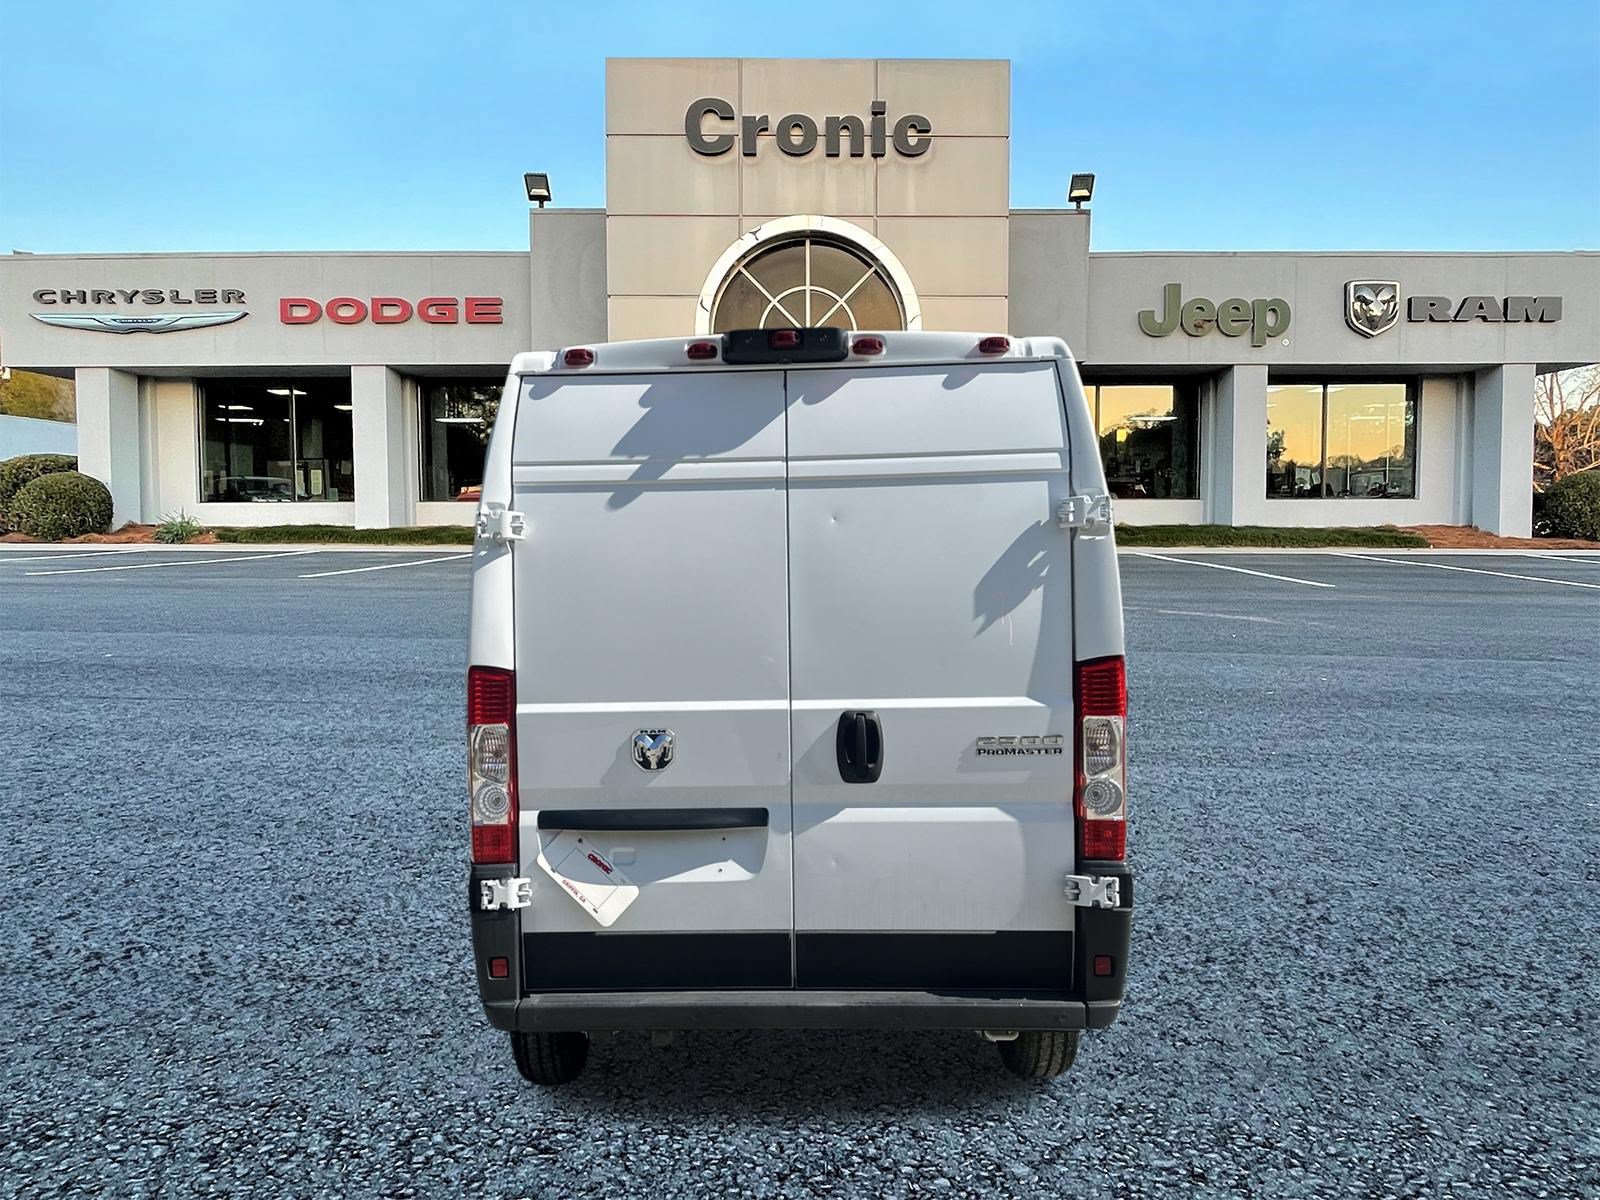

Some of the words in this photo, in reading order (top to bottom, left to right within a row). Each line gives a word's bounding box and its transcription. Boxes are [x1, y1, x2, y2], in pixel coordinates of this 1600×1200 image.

[685, 97, 932, 157] Cronic
[32, 289, 247, 305] CHRYSLER
[280, 297, 503, 324] DODGE
[1408, 296, 1563, 323] RAM
[1138, 283, 1292, 347] Jeep
[976, 735, 1065, 747] 2500
[977, 748, 1063, 756] PROMASTER
